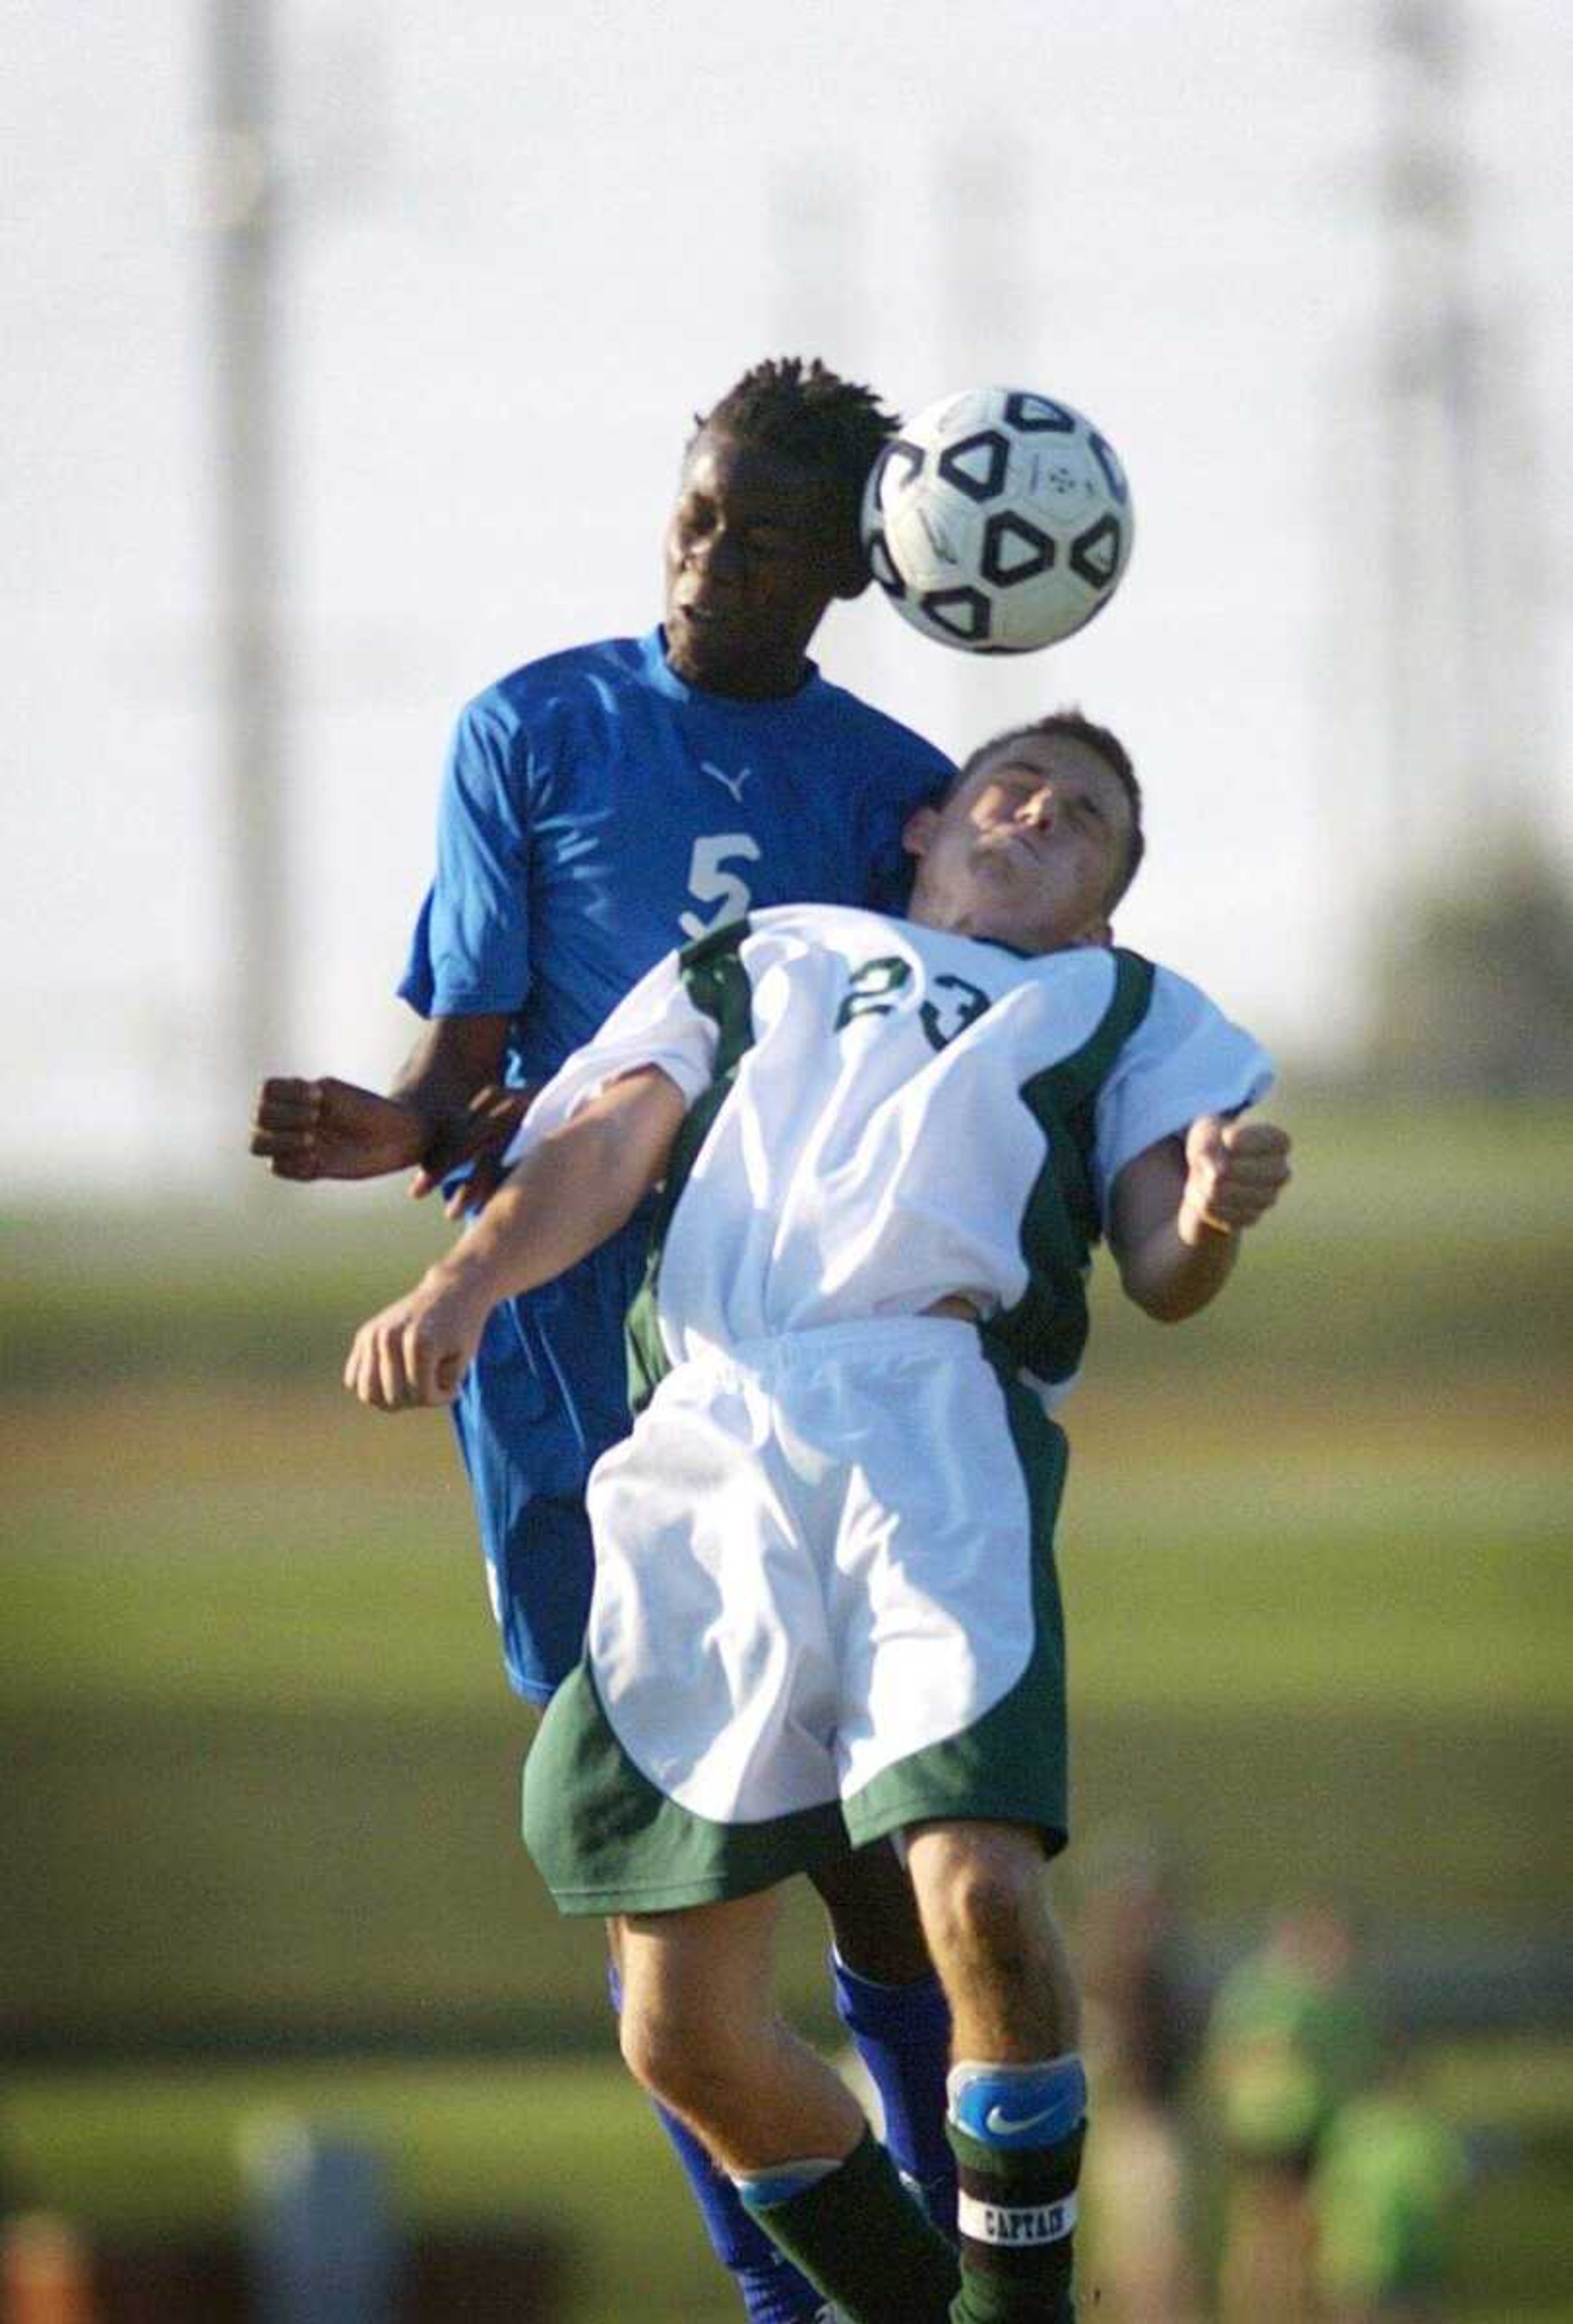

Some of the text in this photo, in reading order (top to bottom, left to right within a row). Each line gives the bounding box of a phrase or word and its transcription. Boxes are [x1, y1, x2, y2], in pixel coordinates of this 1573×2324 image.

[678, 833, 761, 941] 5
[835, 957, 990, 1052] 23
[985, 2207, 1064, 2239] CAPTAIN
